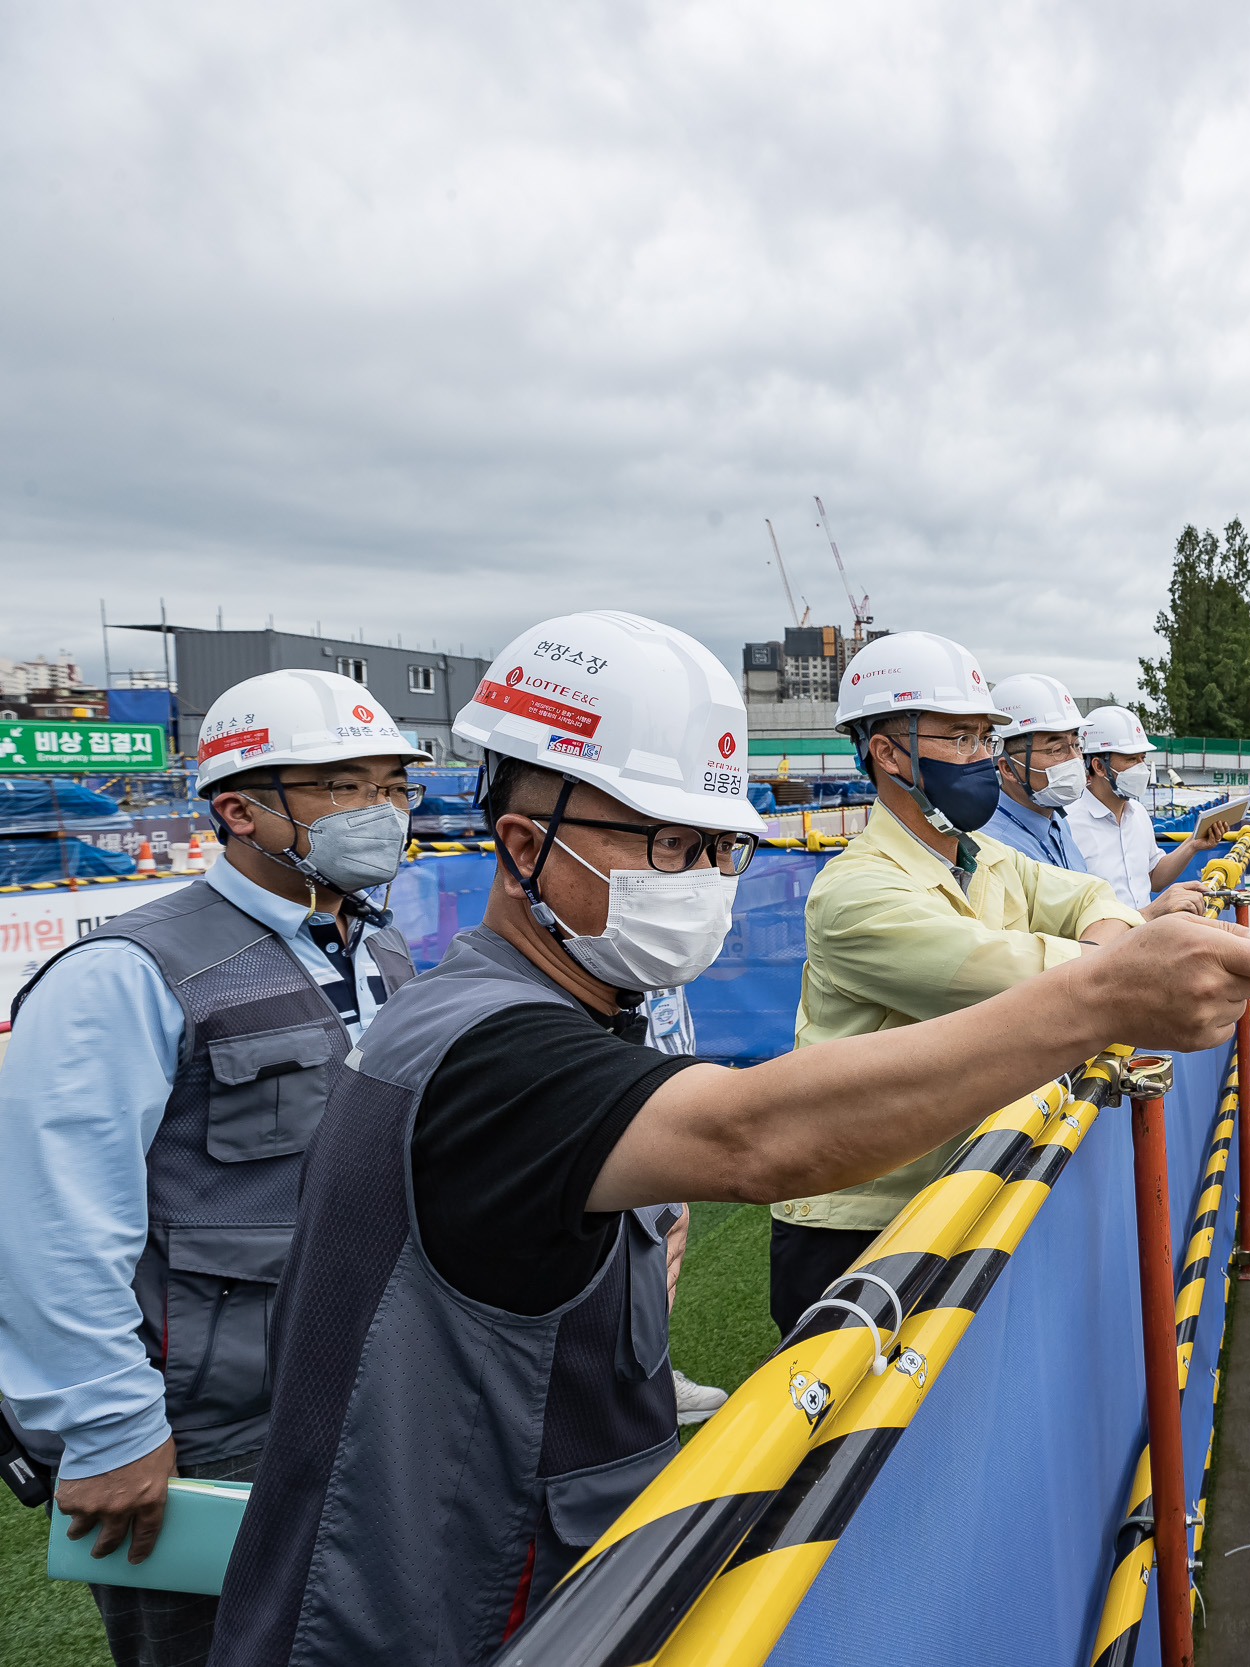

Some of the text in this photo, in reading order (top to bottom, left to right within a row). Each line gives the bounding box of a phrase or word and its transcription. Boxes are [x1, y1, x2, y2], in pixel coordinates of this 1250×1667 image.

[534, 641, 608, 675] 현장소장
[862, 669, 887, 680] LOTTE
[525, 676, 599, 707] LOTTE E&C
[34, 731, 153, 753] 비상 집결지
[36, 752, 153, 763] Emergency assembly point
[703, 771, 743, 796] 임웅정
[1212, 771, 1249, 786] 무재해
[0, 918, 65, 953] 끼임
